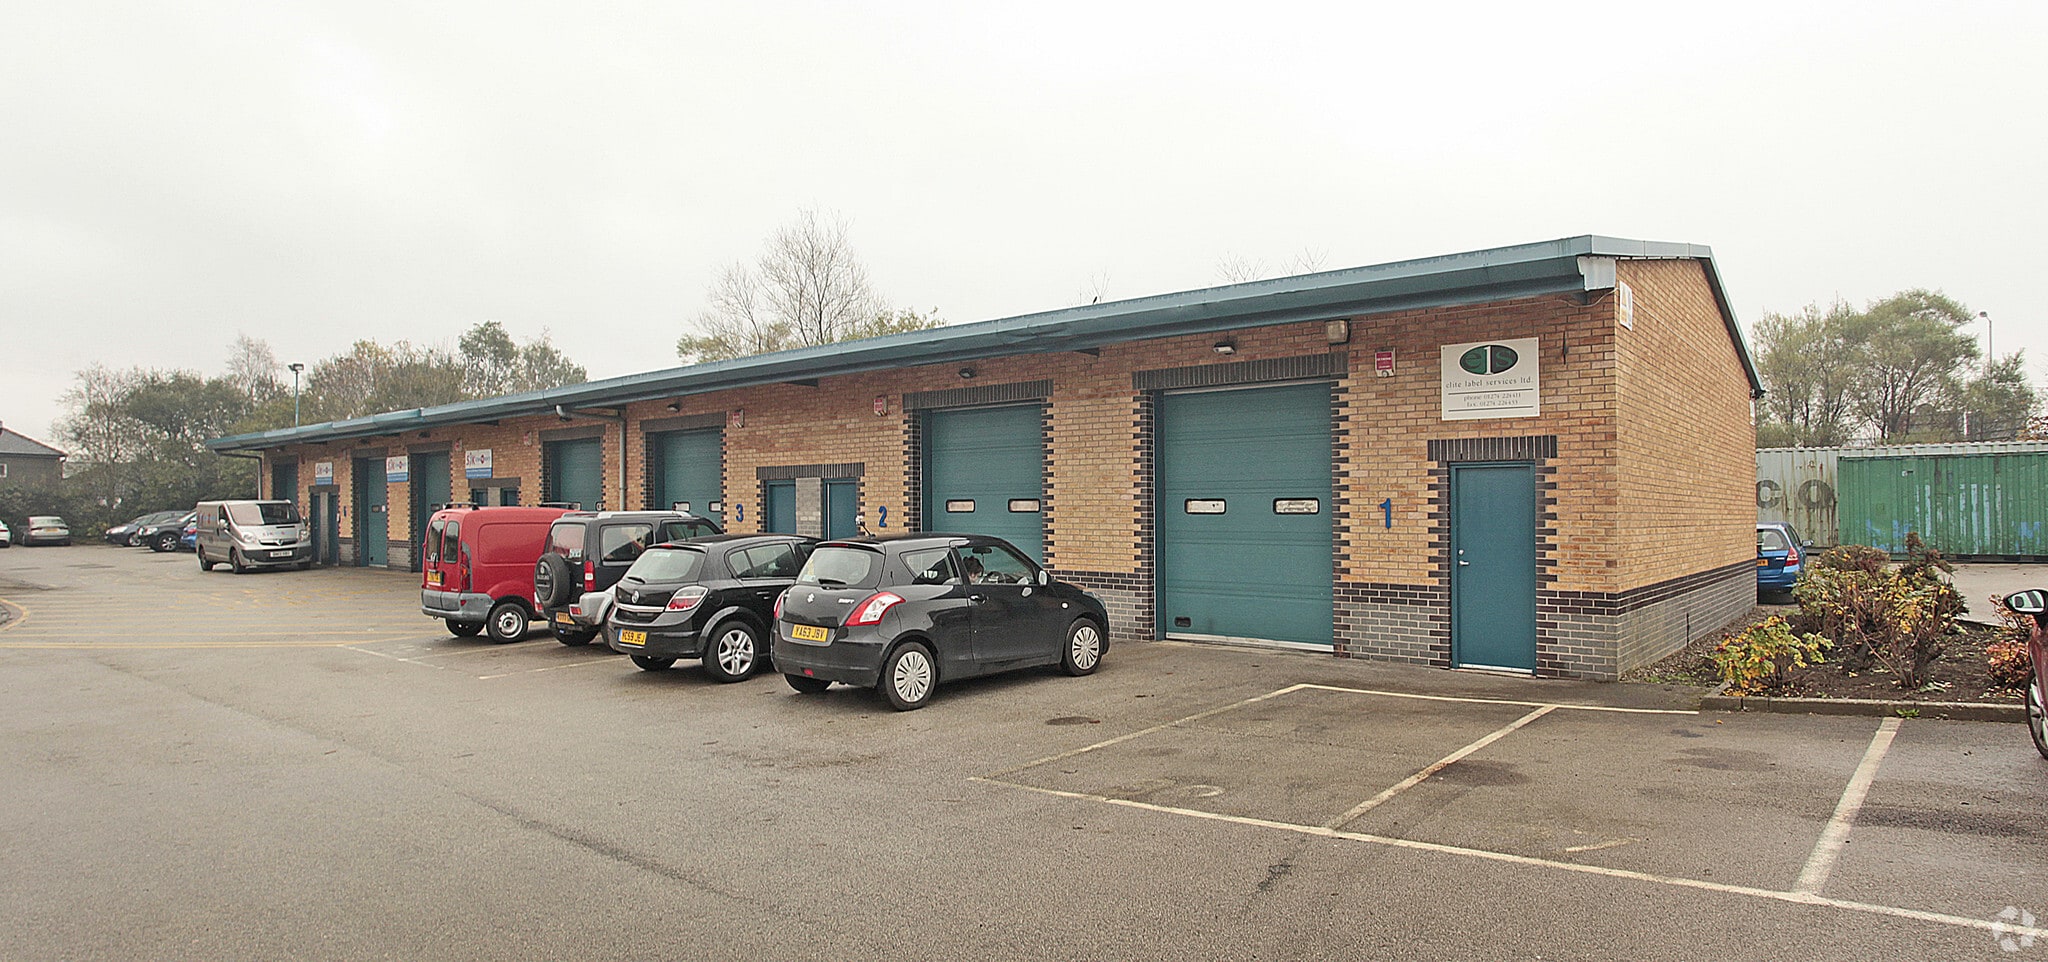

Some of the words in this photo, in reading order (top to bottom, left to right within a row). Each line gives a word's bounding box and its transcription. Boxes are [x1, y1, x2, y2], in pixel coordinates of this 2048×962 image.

[1465, 379, 1482, 387] label
[1486, 377, 1517, 386] services
[735, 503, 744, 522] 3
[878, 505, 888, 528] 2
[1380, 498, 1391, 528] 1
[794, 625, 812, 638] YA63
